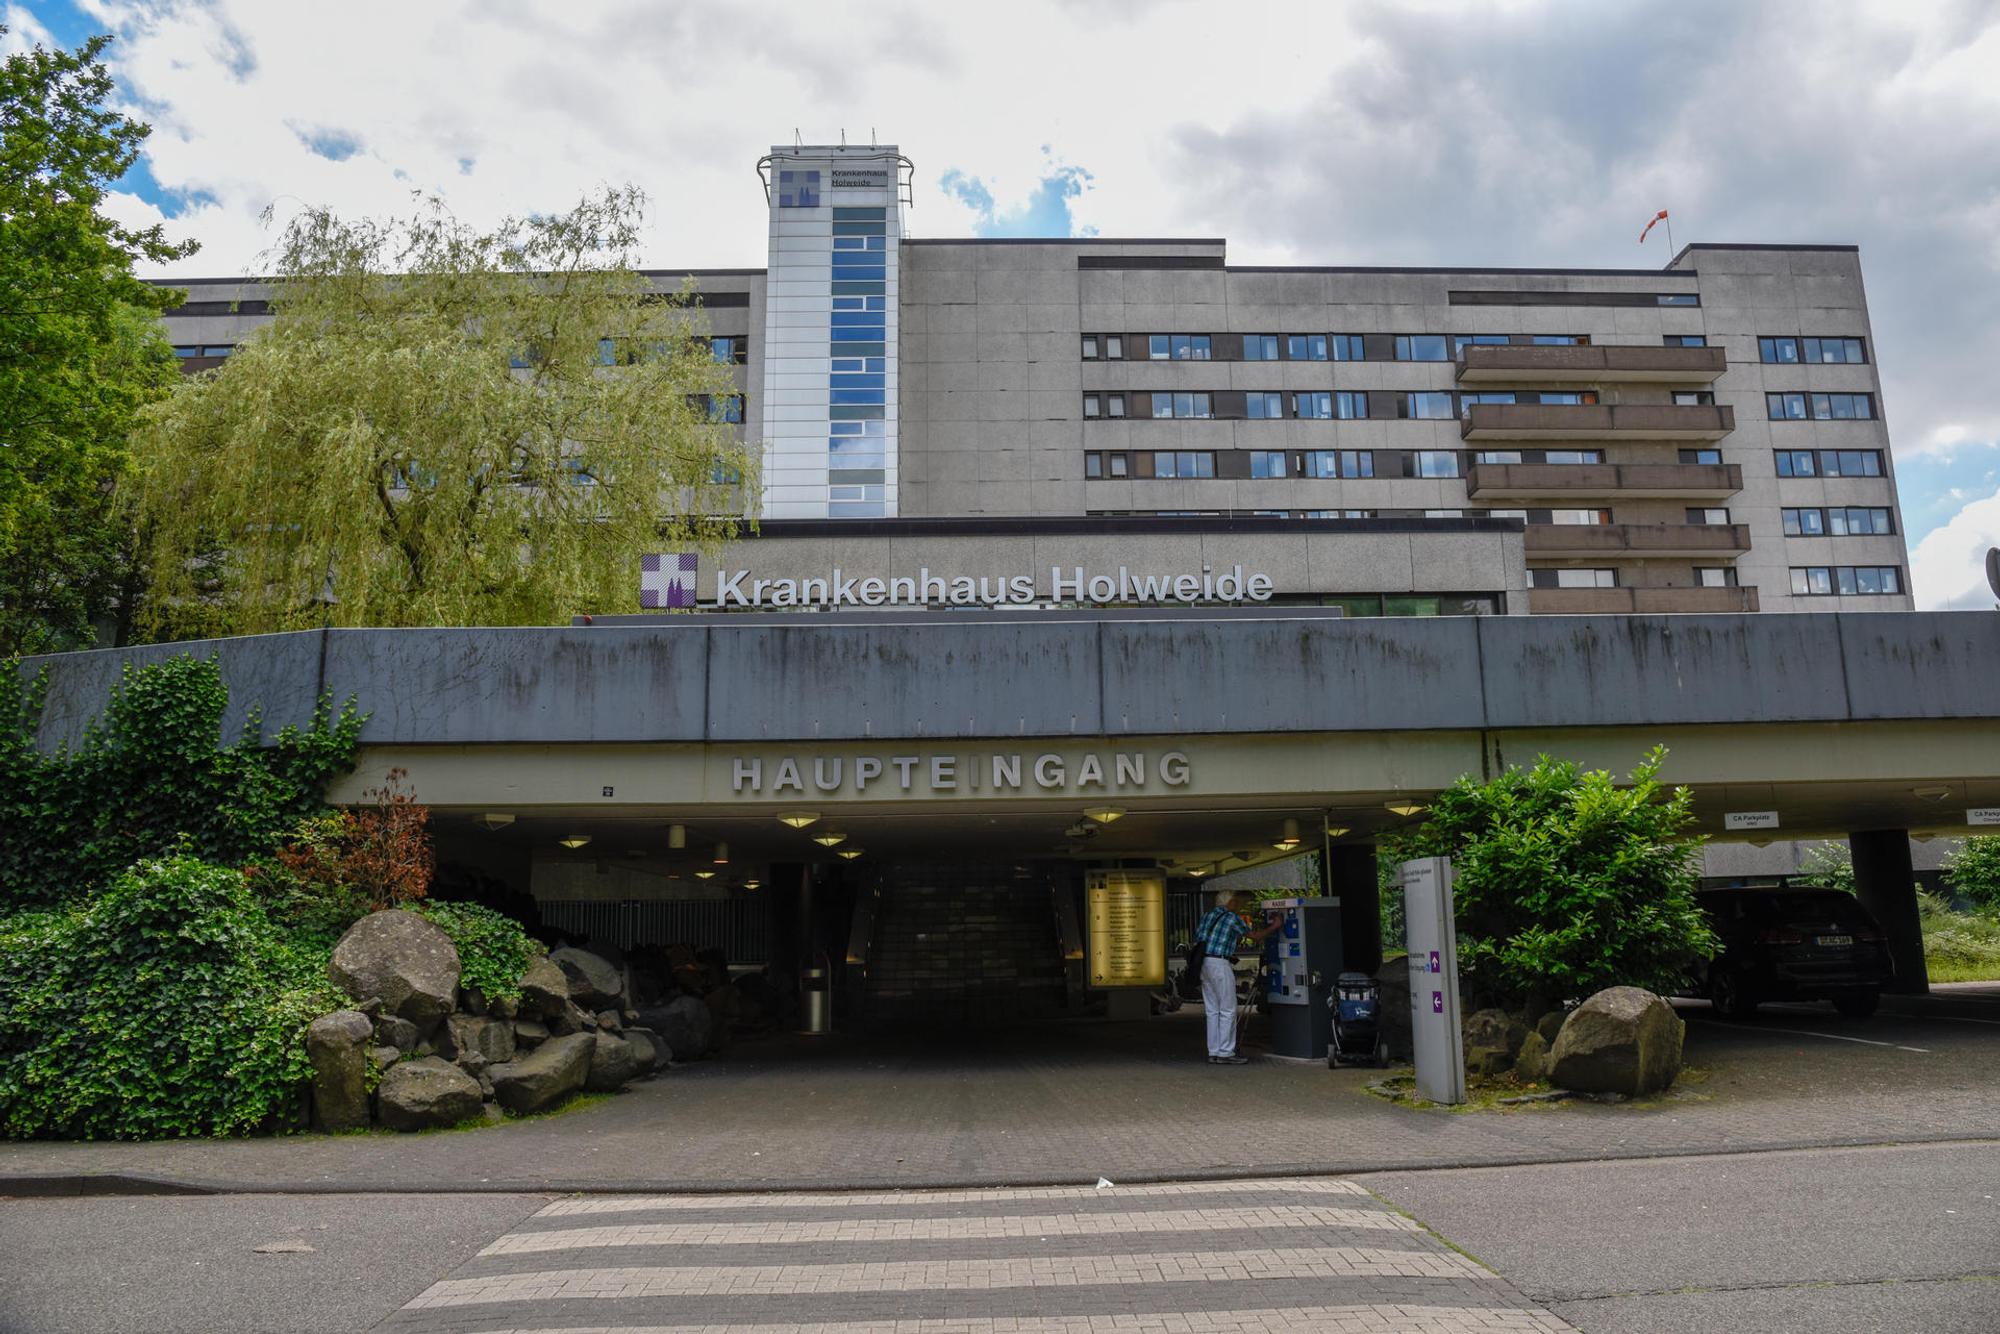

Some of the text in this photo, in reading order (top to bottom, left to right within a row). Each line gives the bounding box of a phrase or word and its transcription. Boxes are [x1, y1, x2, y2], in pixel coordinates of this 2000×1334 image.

[716, 564, 1273, 607] Krankenhaus Holweide
[733, 751, 1191, 791] HAUPTEINGANG
